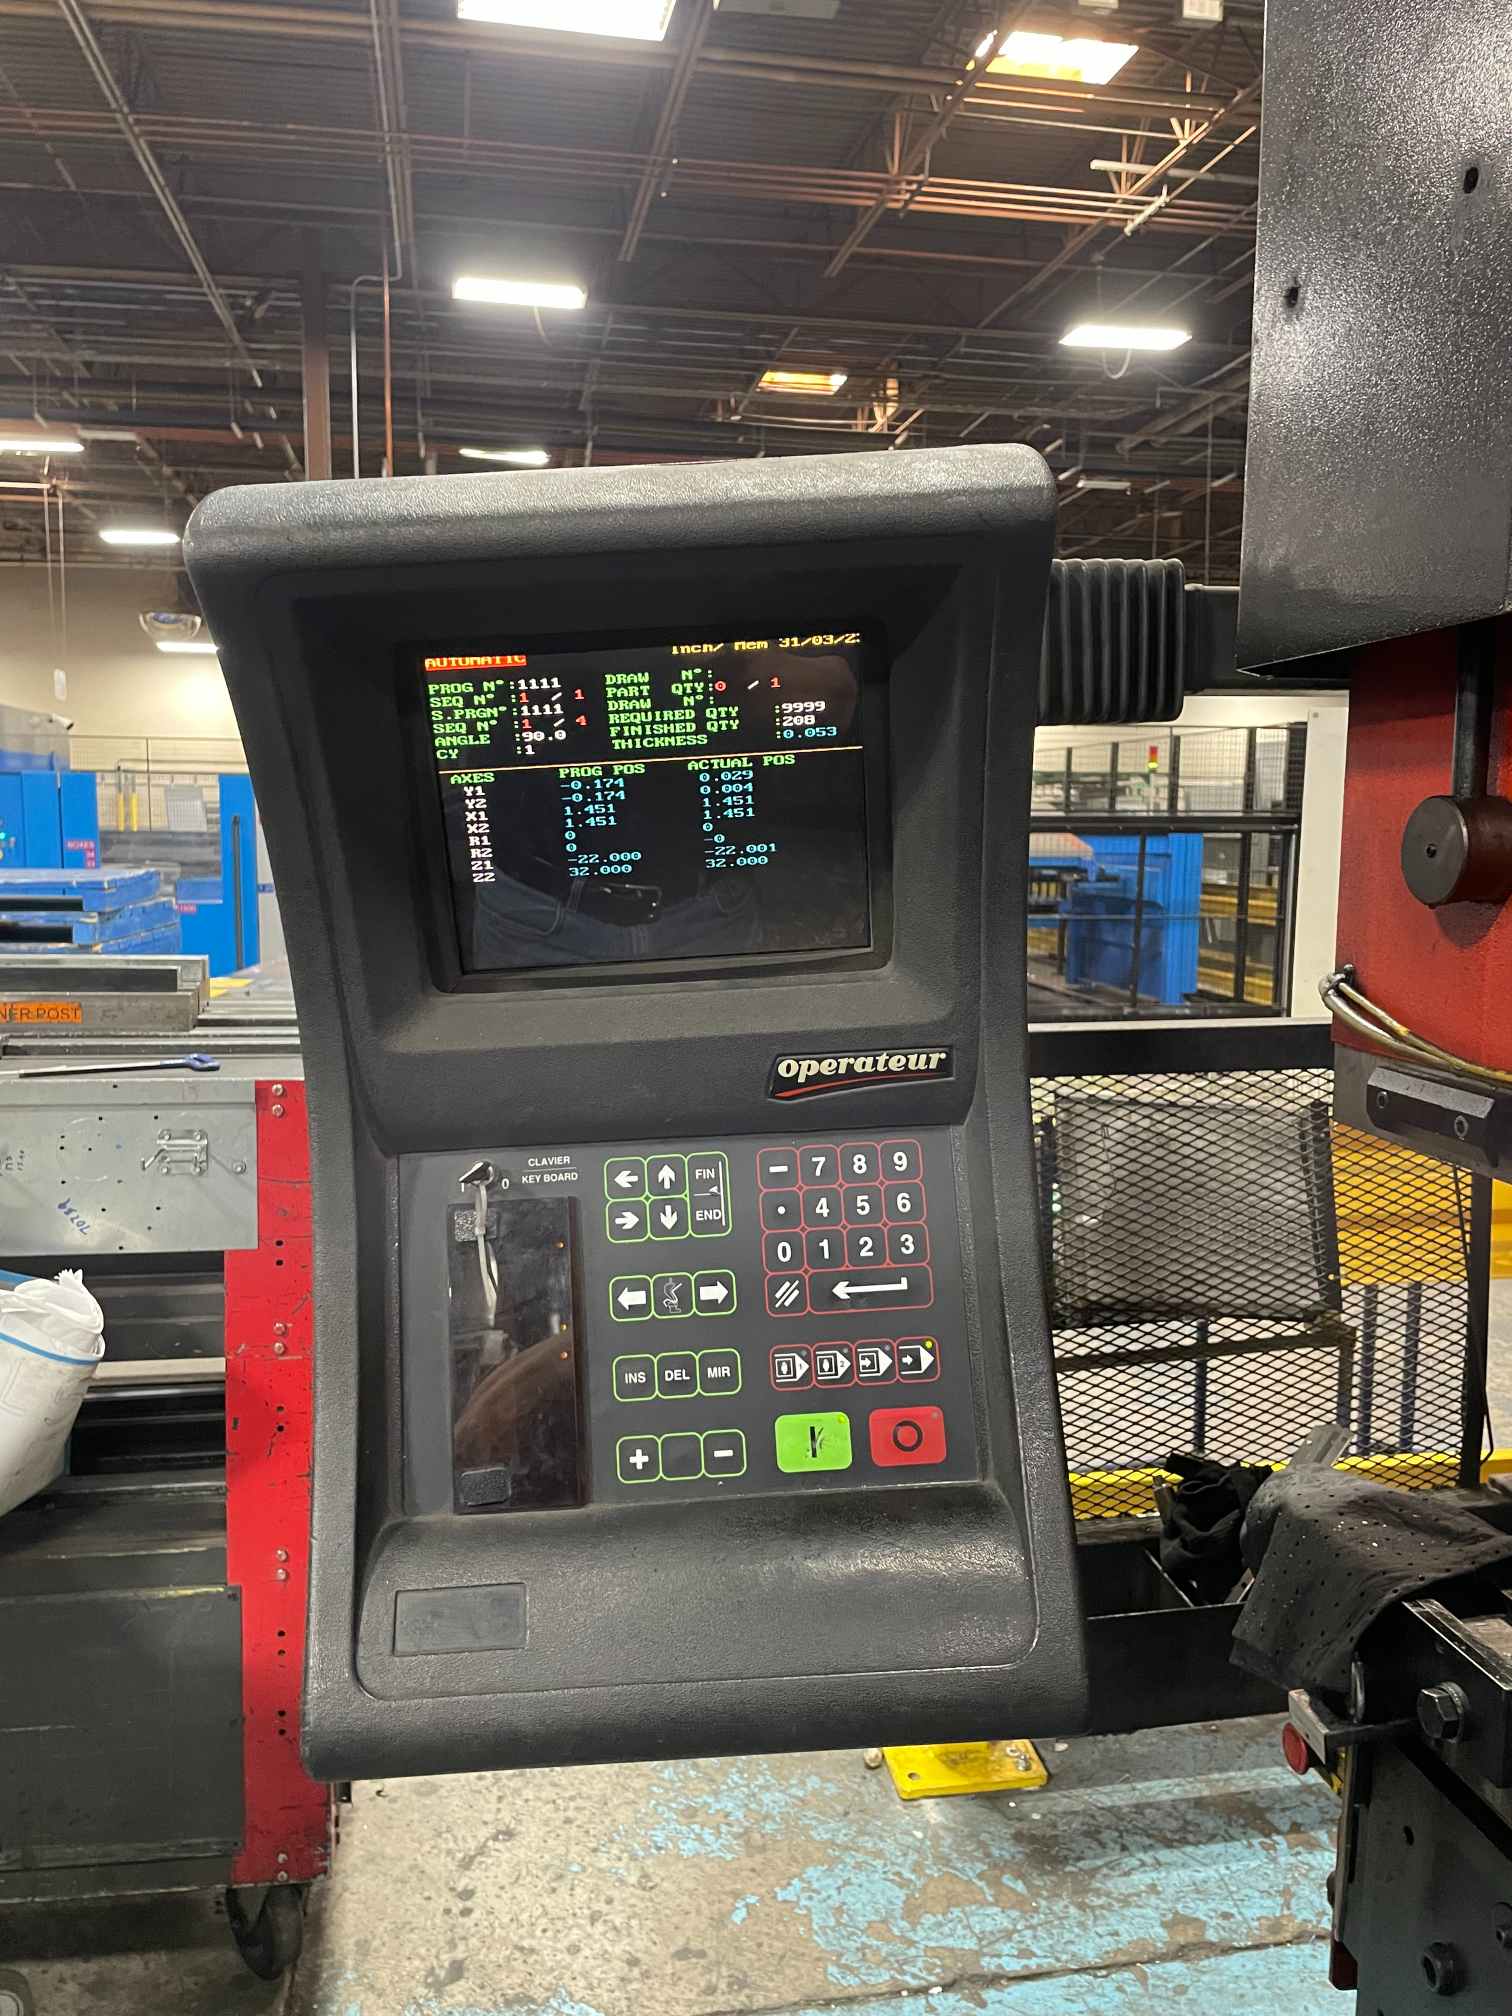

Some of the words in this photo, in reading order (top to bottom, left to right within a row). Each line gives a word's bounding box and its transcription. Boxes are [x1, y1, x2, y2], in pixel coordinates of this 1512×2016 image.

[779, 632, 860, 648] 31/03/2
[605, 672, 649, 685] DRAW
[428, 683, 473, 695] PROG
[606, 686, 650, 698] PART
[430, 697, 463, 708] SEQ
[608, 699, 651, 711] DRAW
[608, 709, 695, 724] REQUIRED
[706, 706, 739, 719] QTY
[433, 722, 467, 734] SEQ
[609, 722, 696, 737] FINISHED
[706, 719, 740, 732] QTY
[434, 734, 491, 747] ANGLE
[612, 734, 708, 750] THICKNESS
[436, 749, 459, 760] CY
[687, 757, 753, 771] ACTUAL
[763, 754, 796, 766] POS
[450, 772, 496, 784] AXES
[559, 766, 603, 778] PROG
[613, 764, 646, 775] POS
[463, 786, 486, 796] Y1
[699, 770, 754, 783] 0.029
[465, 798, 487, 809] Y2
[700, 782, 754, 795] 0.004
[465, 811, 488, 822] X1
[564, 803, 616, 816] 1.451
[703, 795, 755, 808] 1.451
[467, 823, 490, 834] X2
[565, 816, 617, 828] 1.451
[703, 807, 756, 820] 1.451
[469, 836, 492, 847] R1
[564, 830, 577, 841] 0
[702, 822, 714, 832] 0
[470, 848, 493, 859] R2
[565, 842, 578, 853] 0
[471, 860, 494, 871] Z1
[473, 872, 496, 883] Z2
[569, 864, 633, 877] 32.000
[705, 855, 769, 869] 32.000
[36, 1007, 81, 1019] POST
[777, 1051, 947, 1083] operateur
[528, 1156, 571, 1167] CLAVIER
[811, 1156, 826, 1176] 7
[852, 1154, 867, 1174] 8
[893, 1151, 908, 1171] 9
[543, 1172, 578, 1183] BOARD
[695, 1168, 715, 1180] FIN
[815, 1197, 830, 1217] 4
[856, 1195, 870, 1215] 5
[896, 1192, 911, 1213] 6
[695, 1209, 722, 1221] END
[777, 1241, 792, 1262] 0
[819, 1239, 830, 1259] 1
[859, 1236, 874, 1257] 2
[900, 1234, 915, 1255] 3
[625, 1371, 646, 1384] INS
[664, 1368, 690, 1381] DEL
[707, 1366, 731, 1379] MIR
